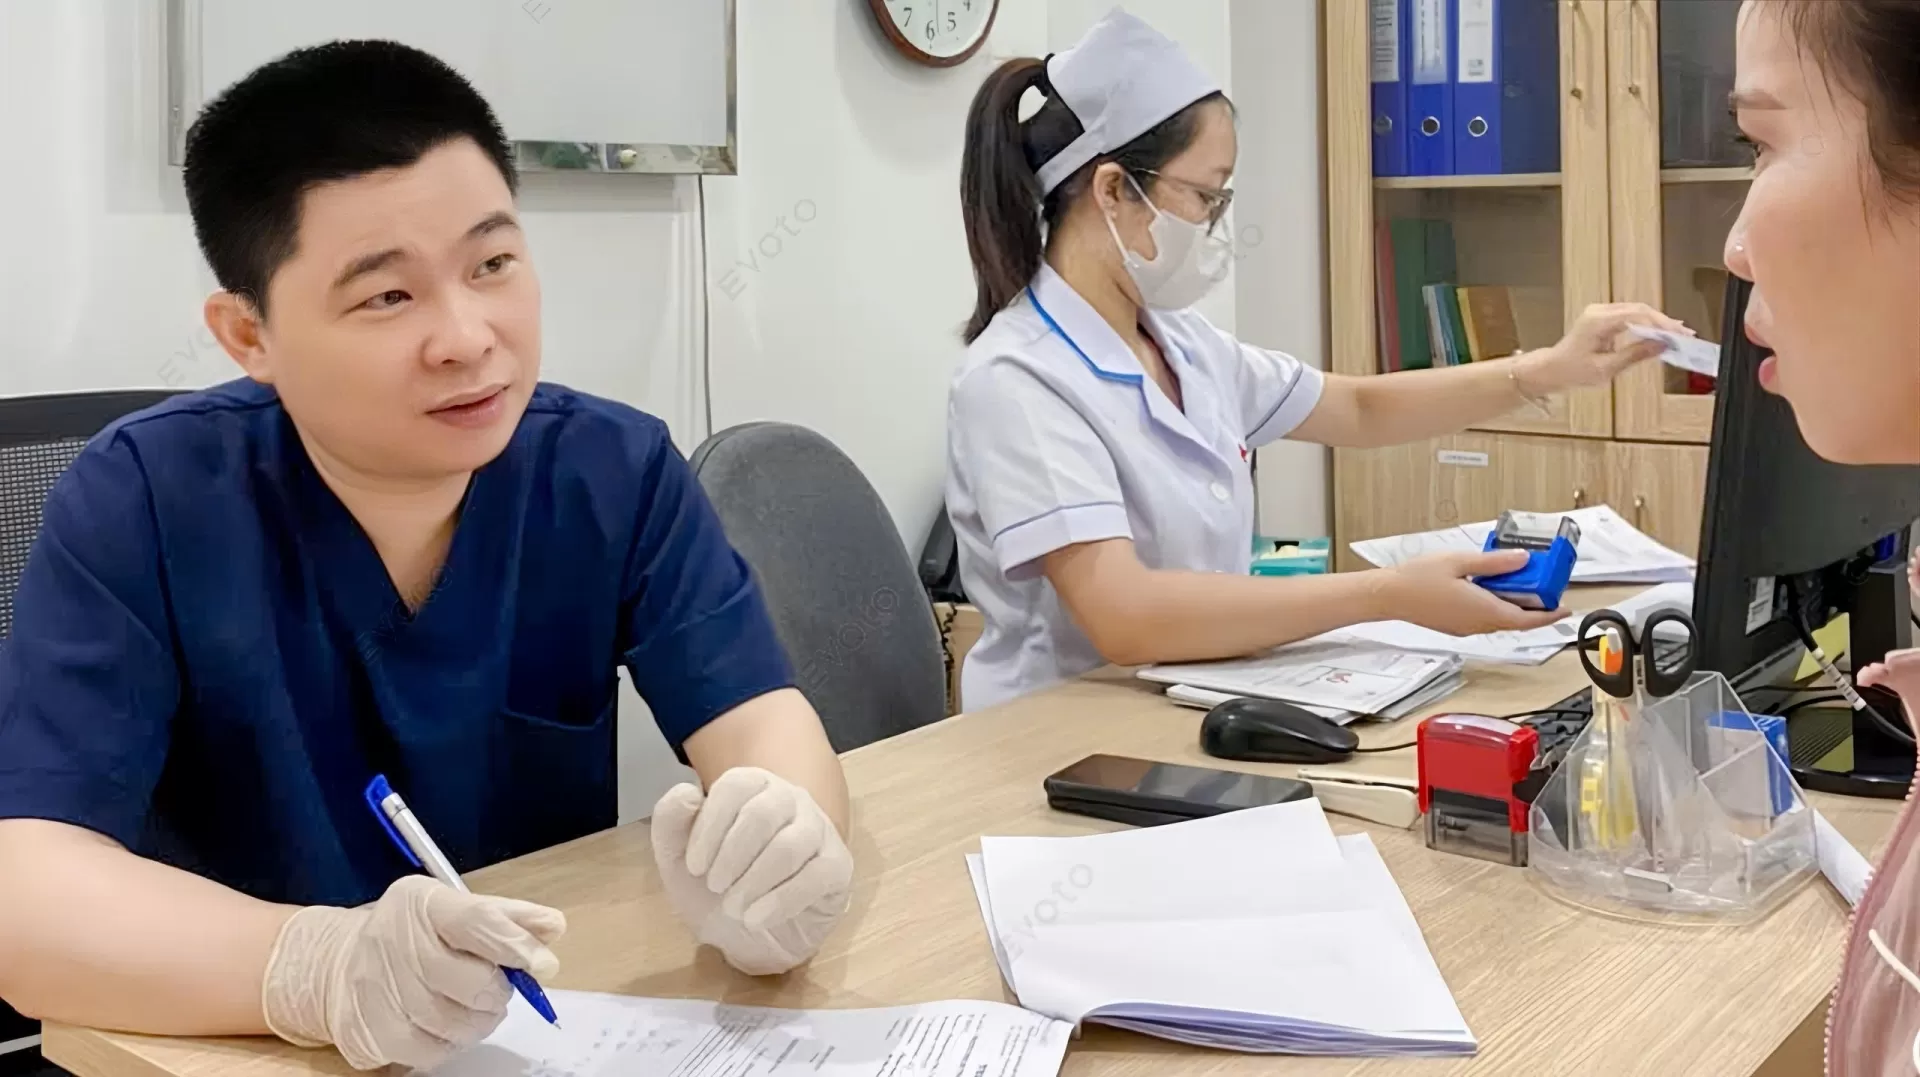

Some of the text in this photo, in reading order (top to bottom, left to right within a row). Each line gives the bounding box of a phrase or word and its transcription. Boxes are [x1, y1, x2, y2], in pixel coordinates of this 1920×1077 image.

[903, 7, 912, 27] 7
[947, 12, 956, 32] 5
[926, 20, 935, 40] 6
